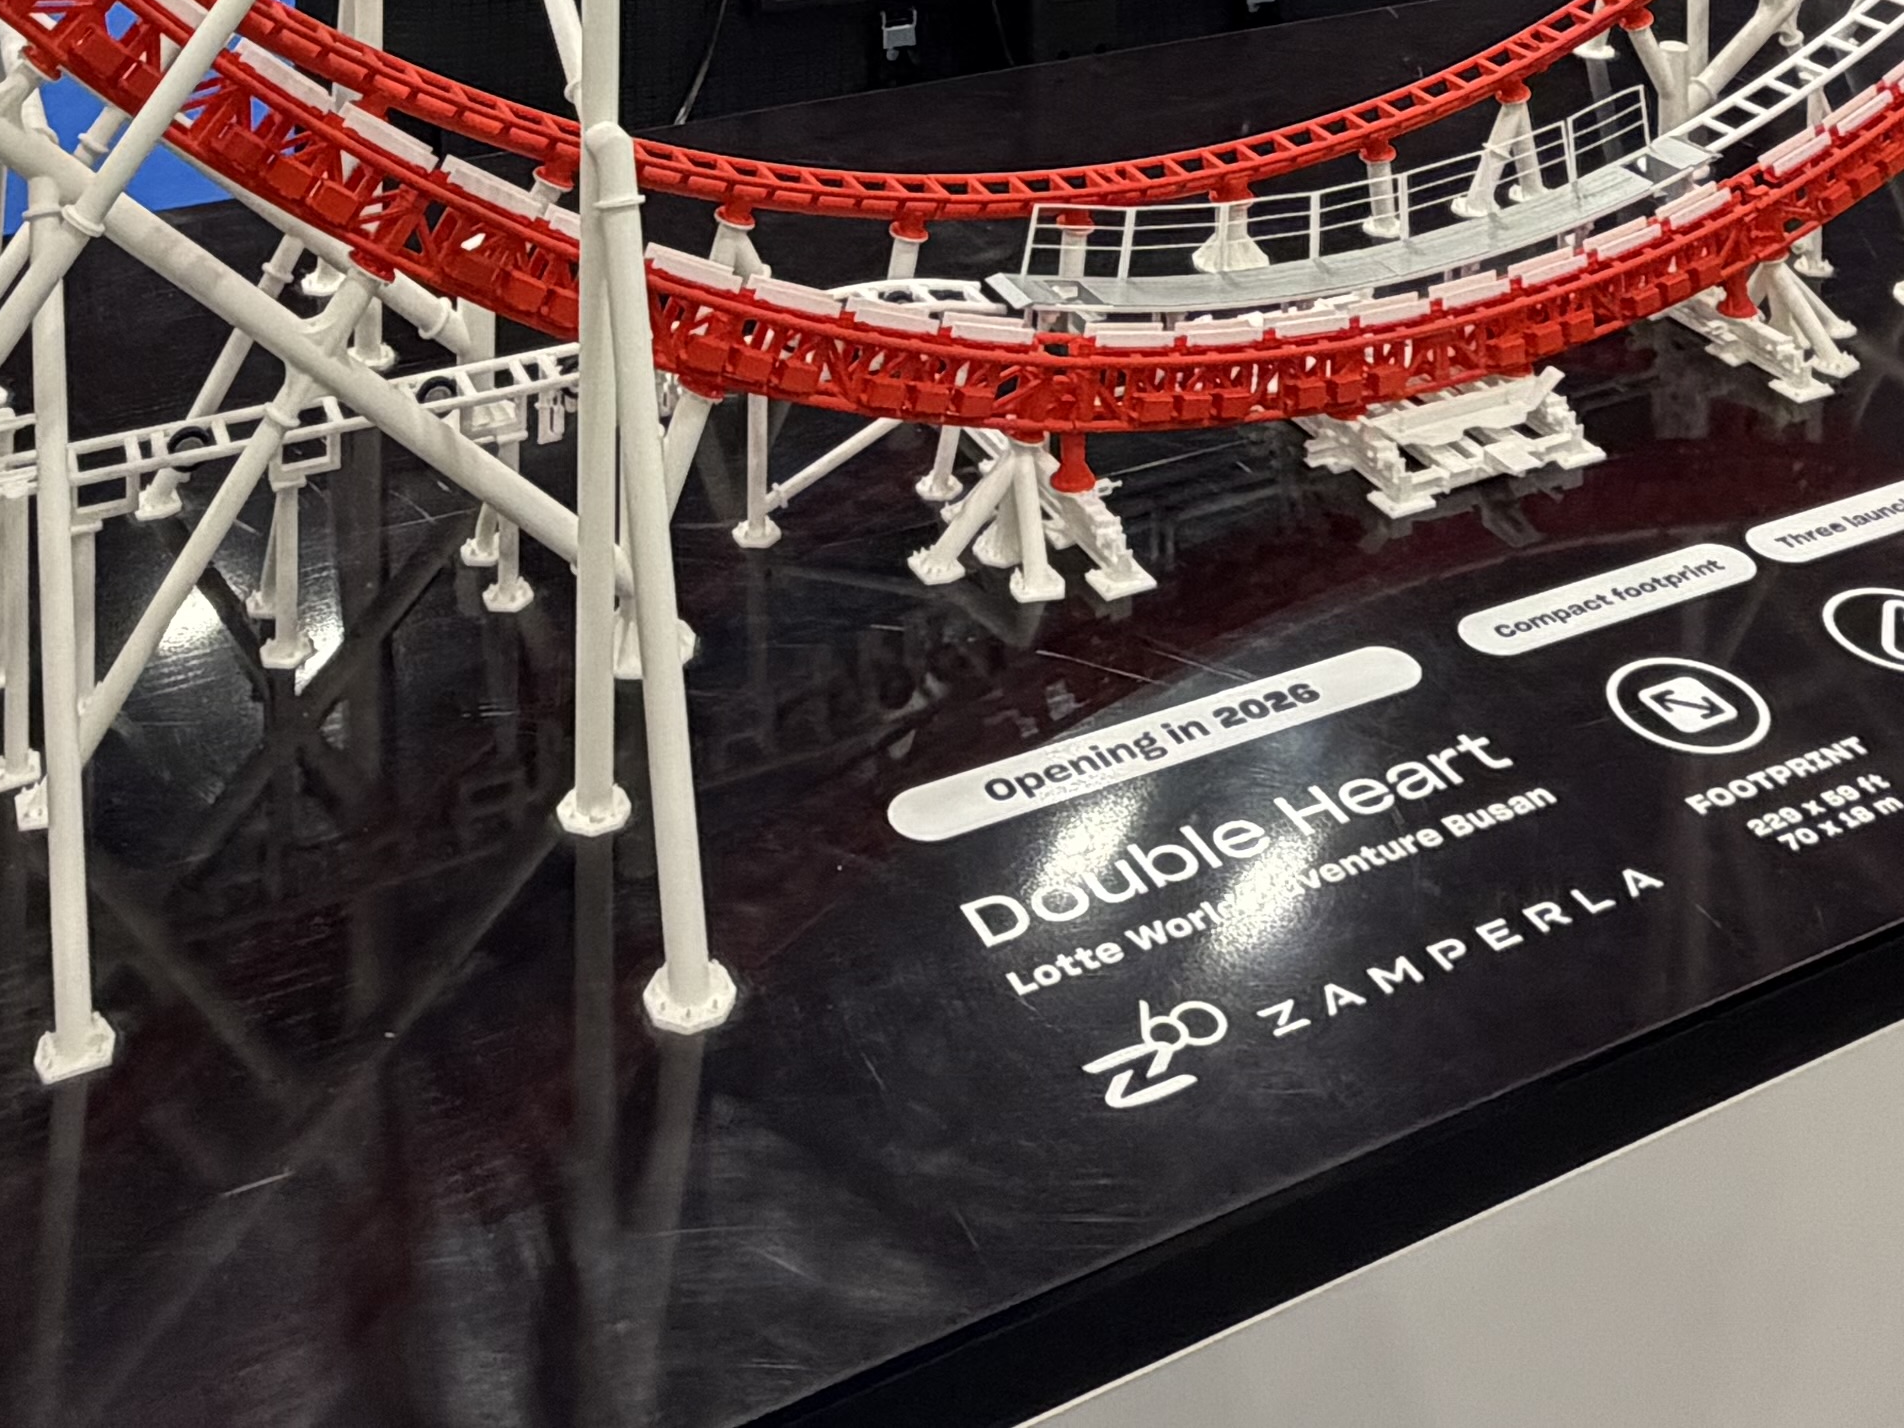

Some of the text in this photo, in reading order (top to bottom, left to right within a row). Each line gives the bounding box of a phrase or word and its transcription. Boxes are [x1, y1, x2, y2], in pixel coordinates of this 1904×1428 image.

[1774, 521, 1846, 551] Three
[1493, 556, 1726, 641] Compact footprint
[982, 682, 1322, 803] Opening in 2026
[1684, 735, 1869, 816] FOOTPRINT
[958, 731, 1515, 949] Double Heart
[1746, 773, 1891, 838] 229 x 59 ft
[1776, 827, 1820, 852] 70
[1817, 819, 1844, 837] x
[1838, 805, 1876, 829] 18
[1005, 935, 1125, 997] Lotte
[1251, 827, 1444, 914] venture
[1438, 783, 1557, 839] Busan
[1257, 867, 1664, 1038] ZAMPERLA
